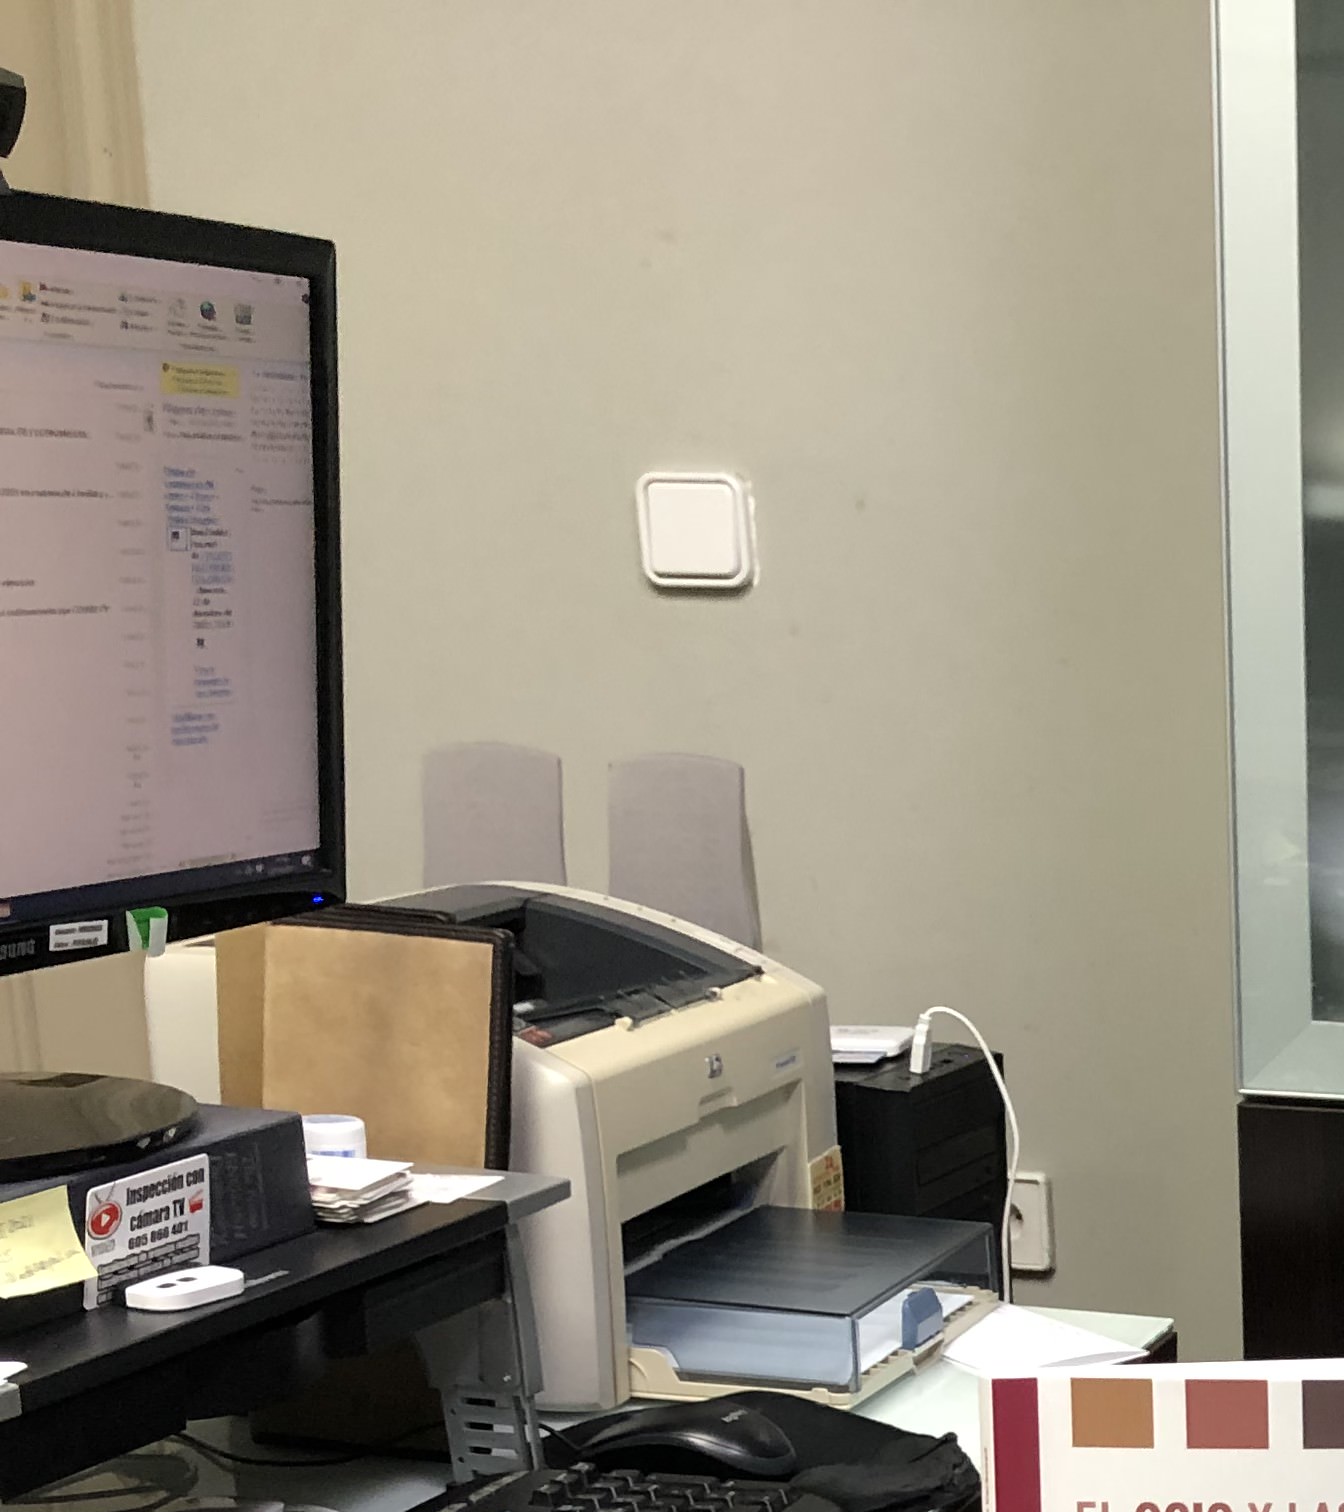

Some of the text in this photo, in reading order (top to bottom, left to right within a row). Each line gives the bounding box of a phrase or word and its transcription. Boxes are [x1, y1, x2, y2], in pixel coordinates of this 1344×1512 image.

[126, 1168, 204, 1206] Inspección con
[129, 1198, 185, 1232] cámara TV
